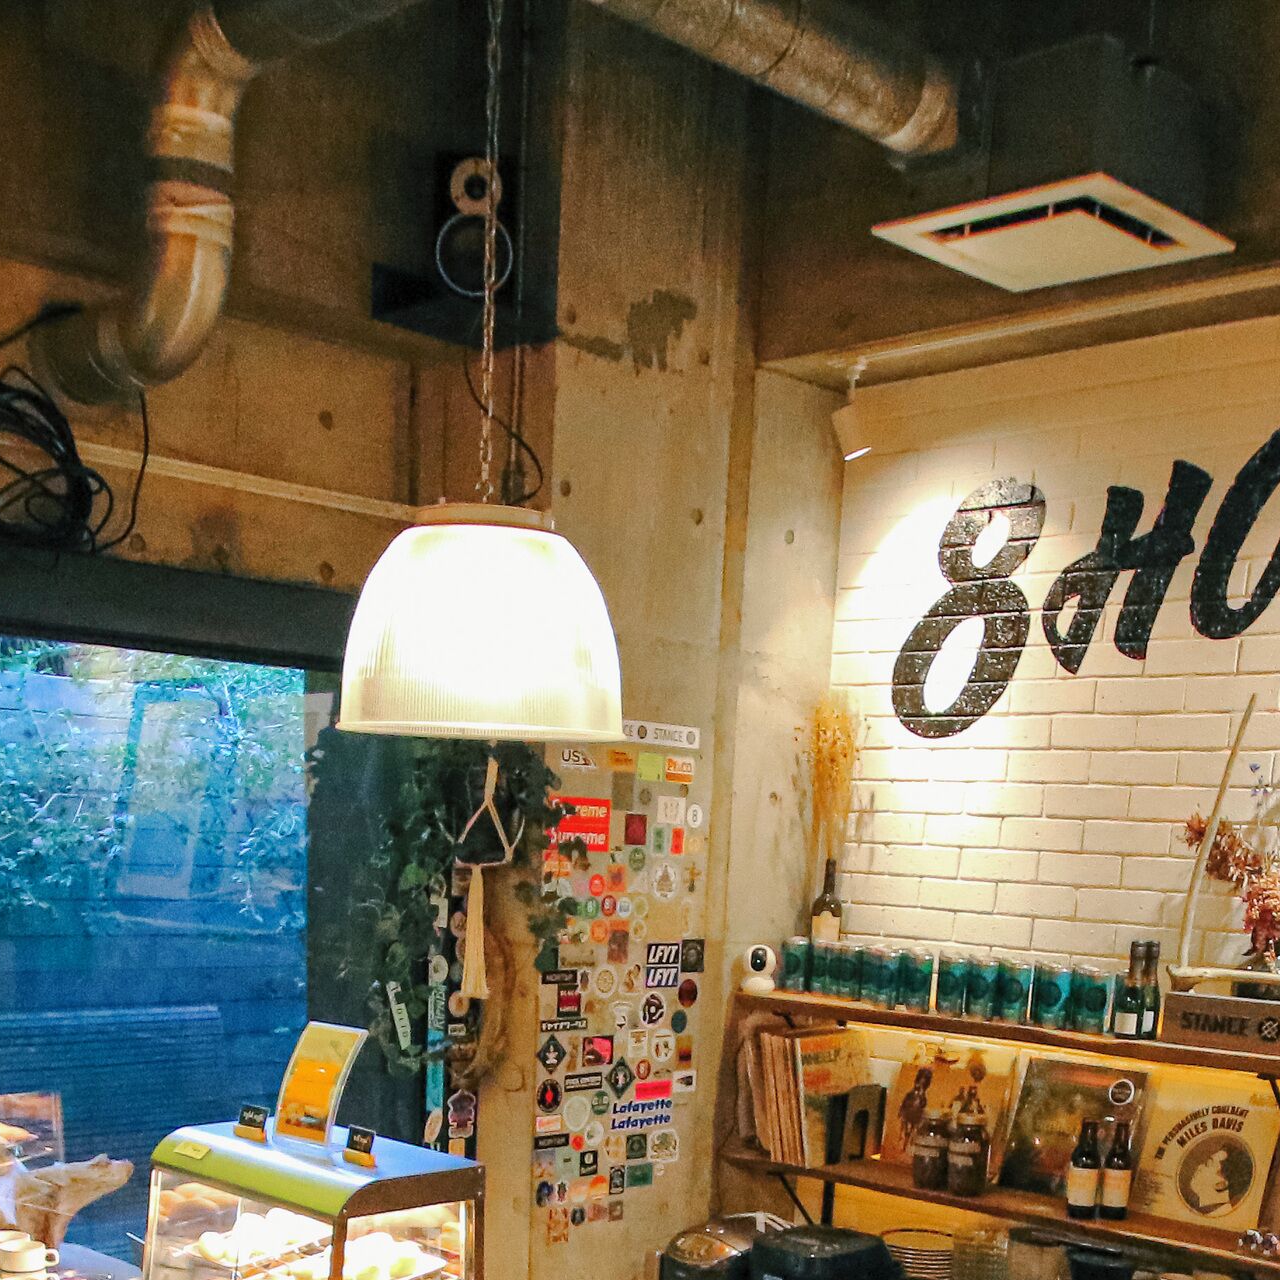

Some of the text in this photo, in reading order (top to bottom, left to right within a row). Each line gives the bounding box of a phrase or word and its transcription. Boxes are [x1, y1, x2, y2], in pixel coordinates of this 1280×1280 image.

[653, 727, 684, 743] STANCE
[1180, 1011, 1251, 1037] STANCE
[612, 1098, 673, 1114] Lafayette
[611, 1114, 671, 1130] Lafayette
[1176, 1117, 1244, 1148] MILES DAVIS
